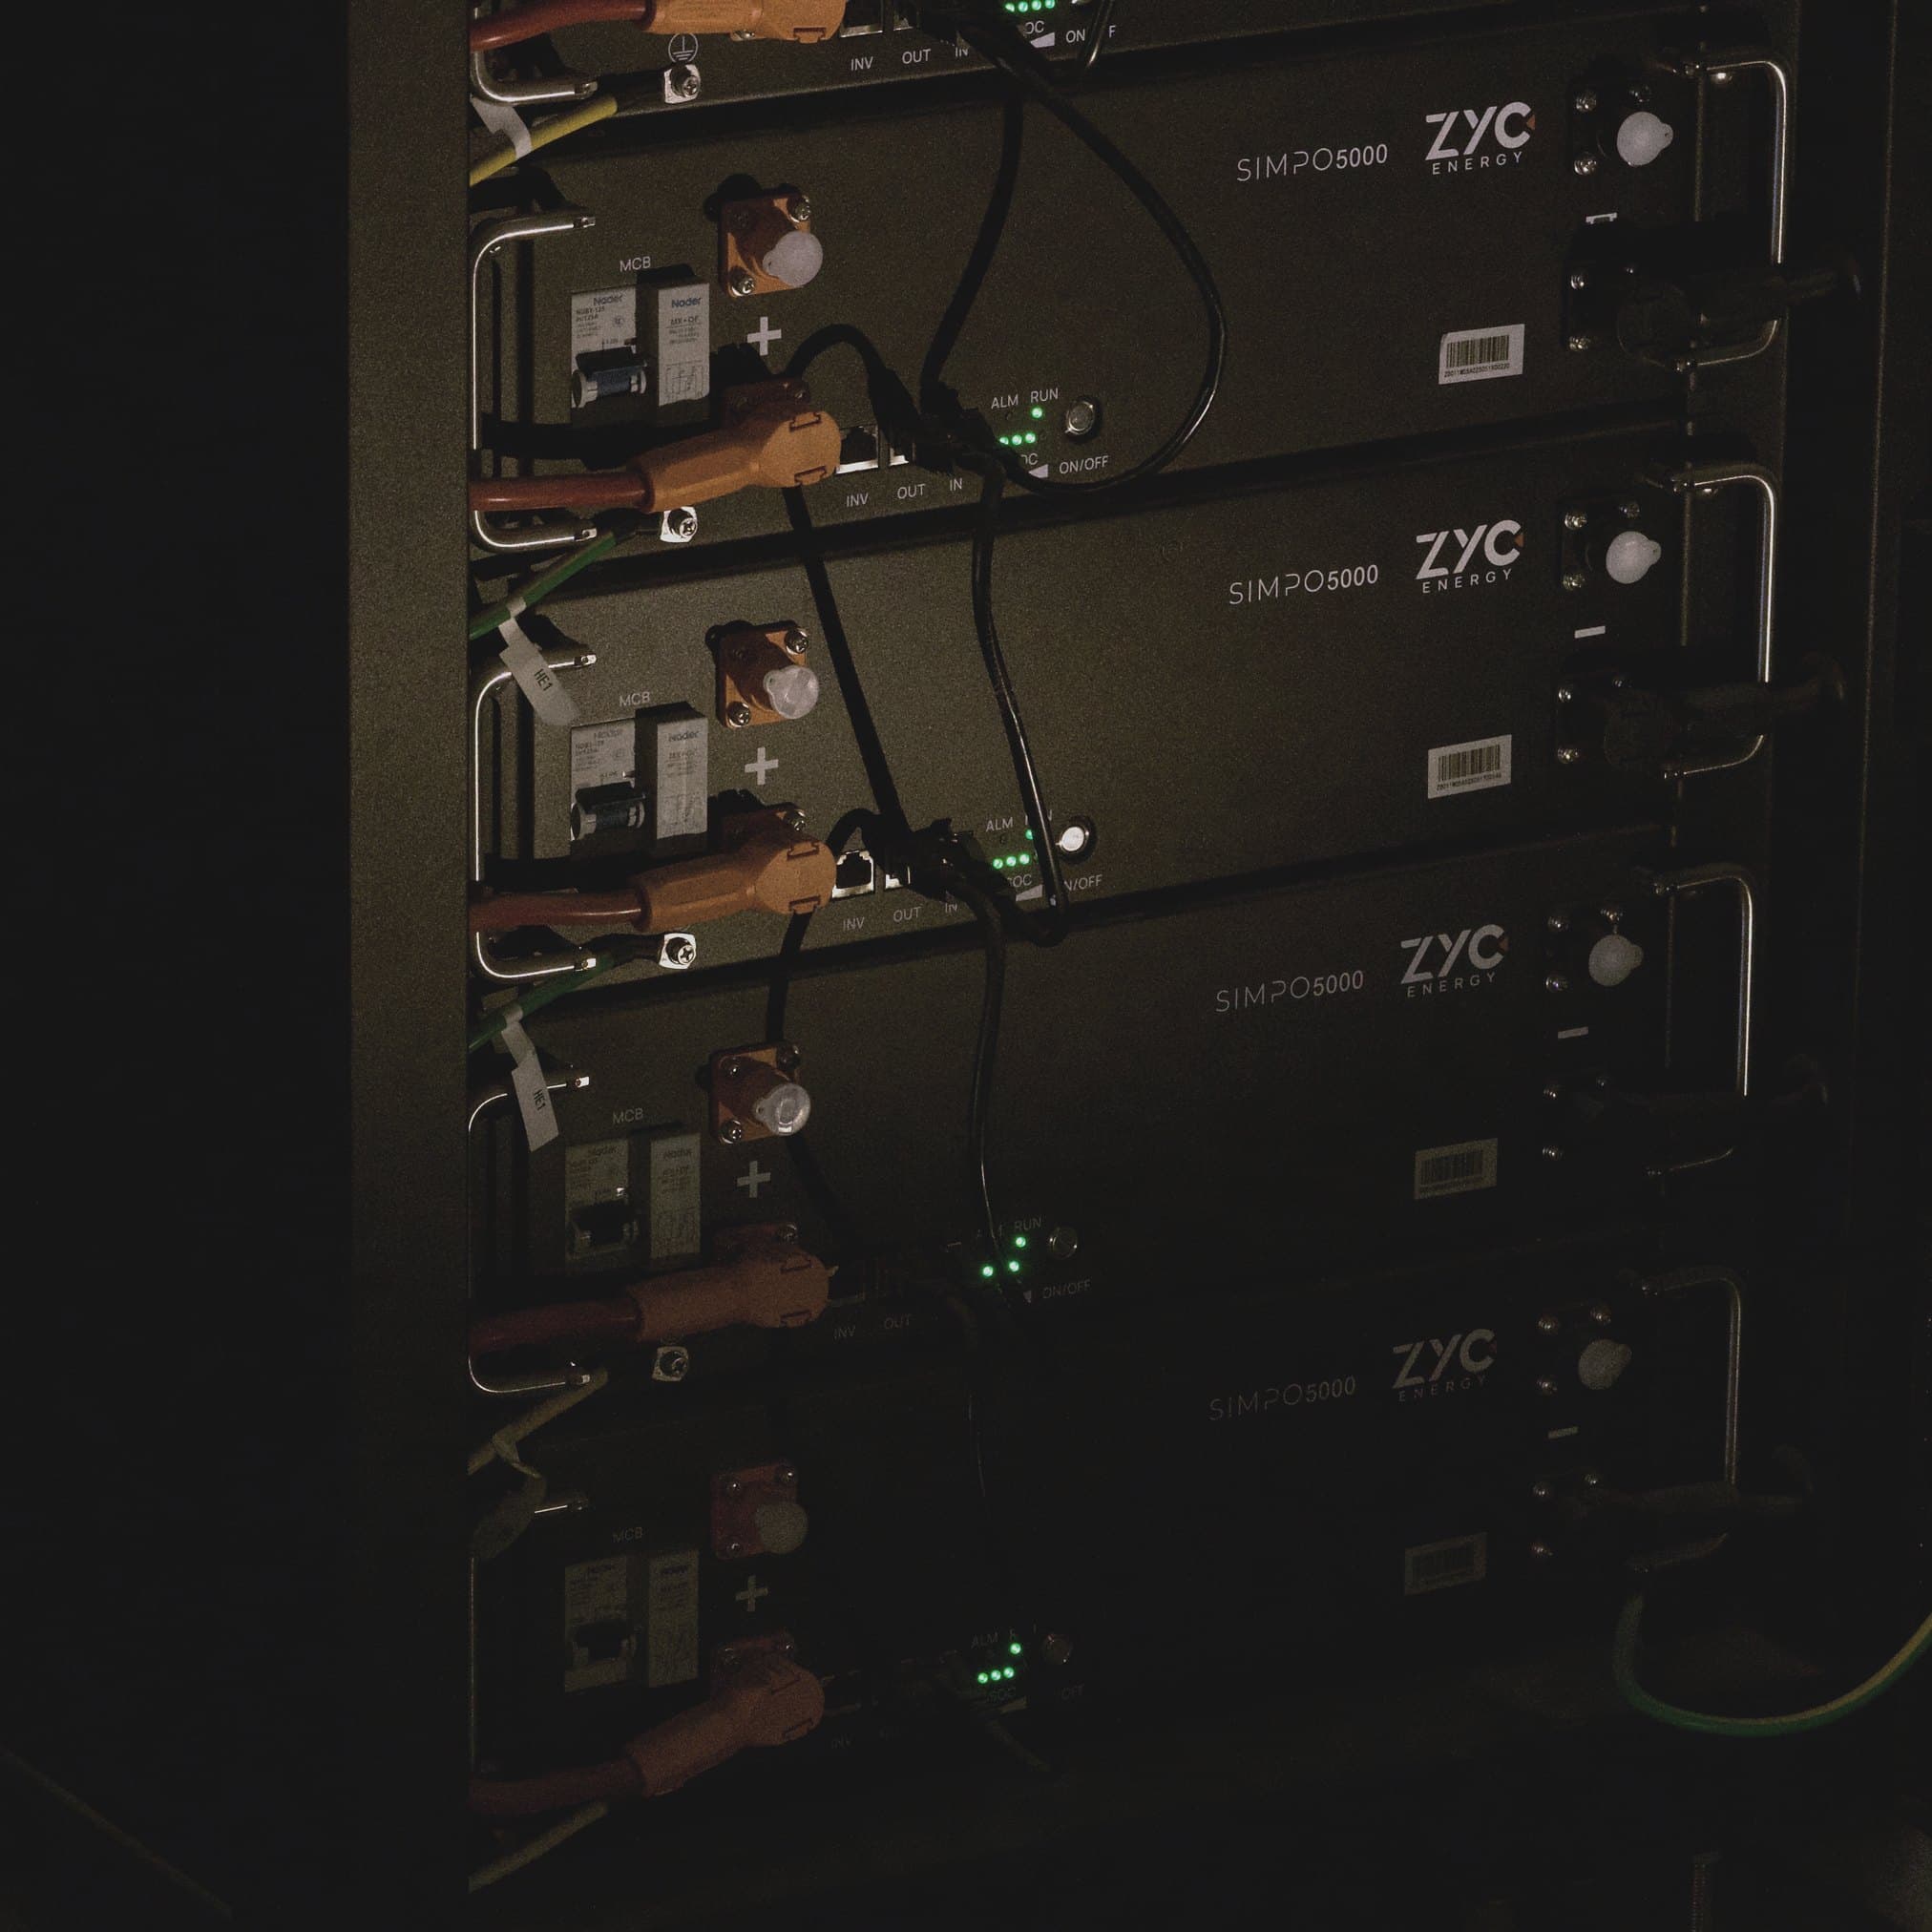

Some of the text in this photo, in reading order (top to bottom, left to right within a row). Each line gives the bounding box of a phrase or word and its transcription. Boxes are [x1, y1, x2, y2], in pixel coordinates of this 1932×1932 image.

[1024, 20, 1044, 35] OC
[850, 56, 874, 72] INV
[901, 48, 932, 65] OUT
[1425, 100, 1533, 161] ZYC
[1236, 143, 1388, 182] SIMPO5000
[1432, 150, 1522, 176] ENERGY
[620, 256, 651, 273] MCB
[671, 297, 703, 308] Nader
[991, 393, 1019, 410] ALM
[1030, 388, 1059, 404] RUN
[1059, 454, 1109, 475] ON/OFF
[896, 483, 926, 500] OUT
[949, 478, 963, 492] IN
[846, 492, 869, 508] INV
[1416, 519, 1522, 580] ZYC
[1228, 564, 1379, 605] SIMPO5000
[1421, 568, 1512, 595] ENERGY
[535, 668, 553, 691] HE1
[620, 691, 651, 707] MCB
[985, 817, 1014, 832] ALM
[1063, 873, 1102, 892] N/OFF
[892, 907, 921, 923] OUT
[843, 916, 866, 932] INV
[1400, 923, 1506, 985] ZYC
[1215, 970, 1364, 1013] SIMPO5000
[1406, 972, 1496, 998] ENERGY
[612, 1107, 643, 1124] MCB
[1014, 1216, 1042, 1232] RUN
[1042, 1278, 1092, 1300] ON/OFF
[884, 1314, 912, 1331] OUT
[833, 1325, 857, 1341] INV
[1393, 1328, 1496, 1390] ZYC
[1398, 1375, 1488, 1403] ENERGY
[1208, 1376, 1355, 1421] SIMPO5000
[612, 1526, 643, 1544] MCB
